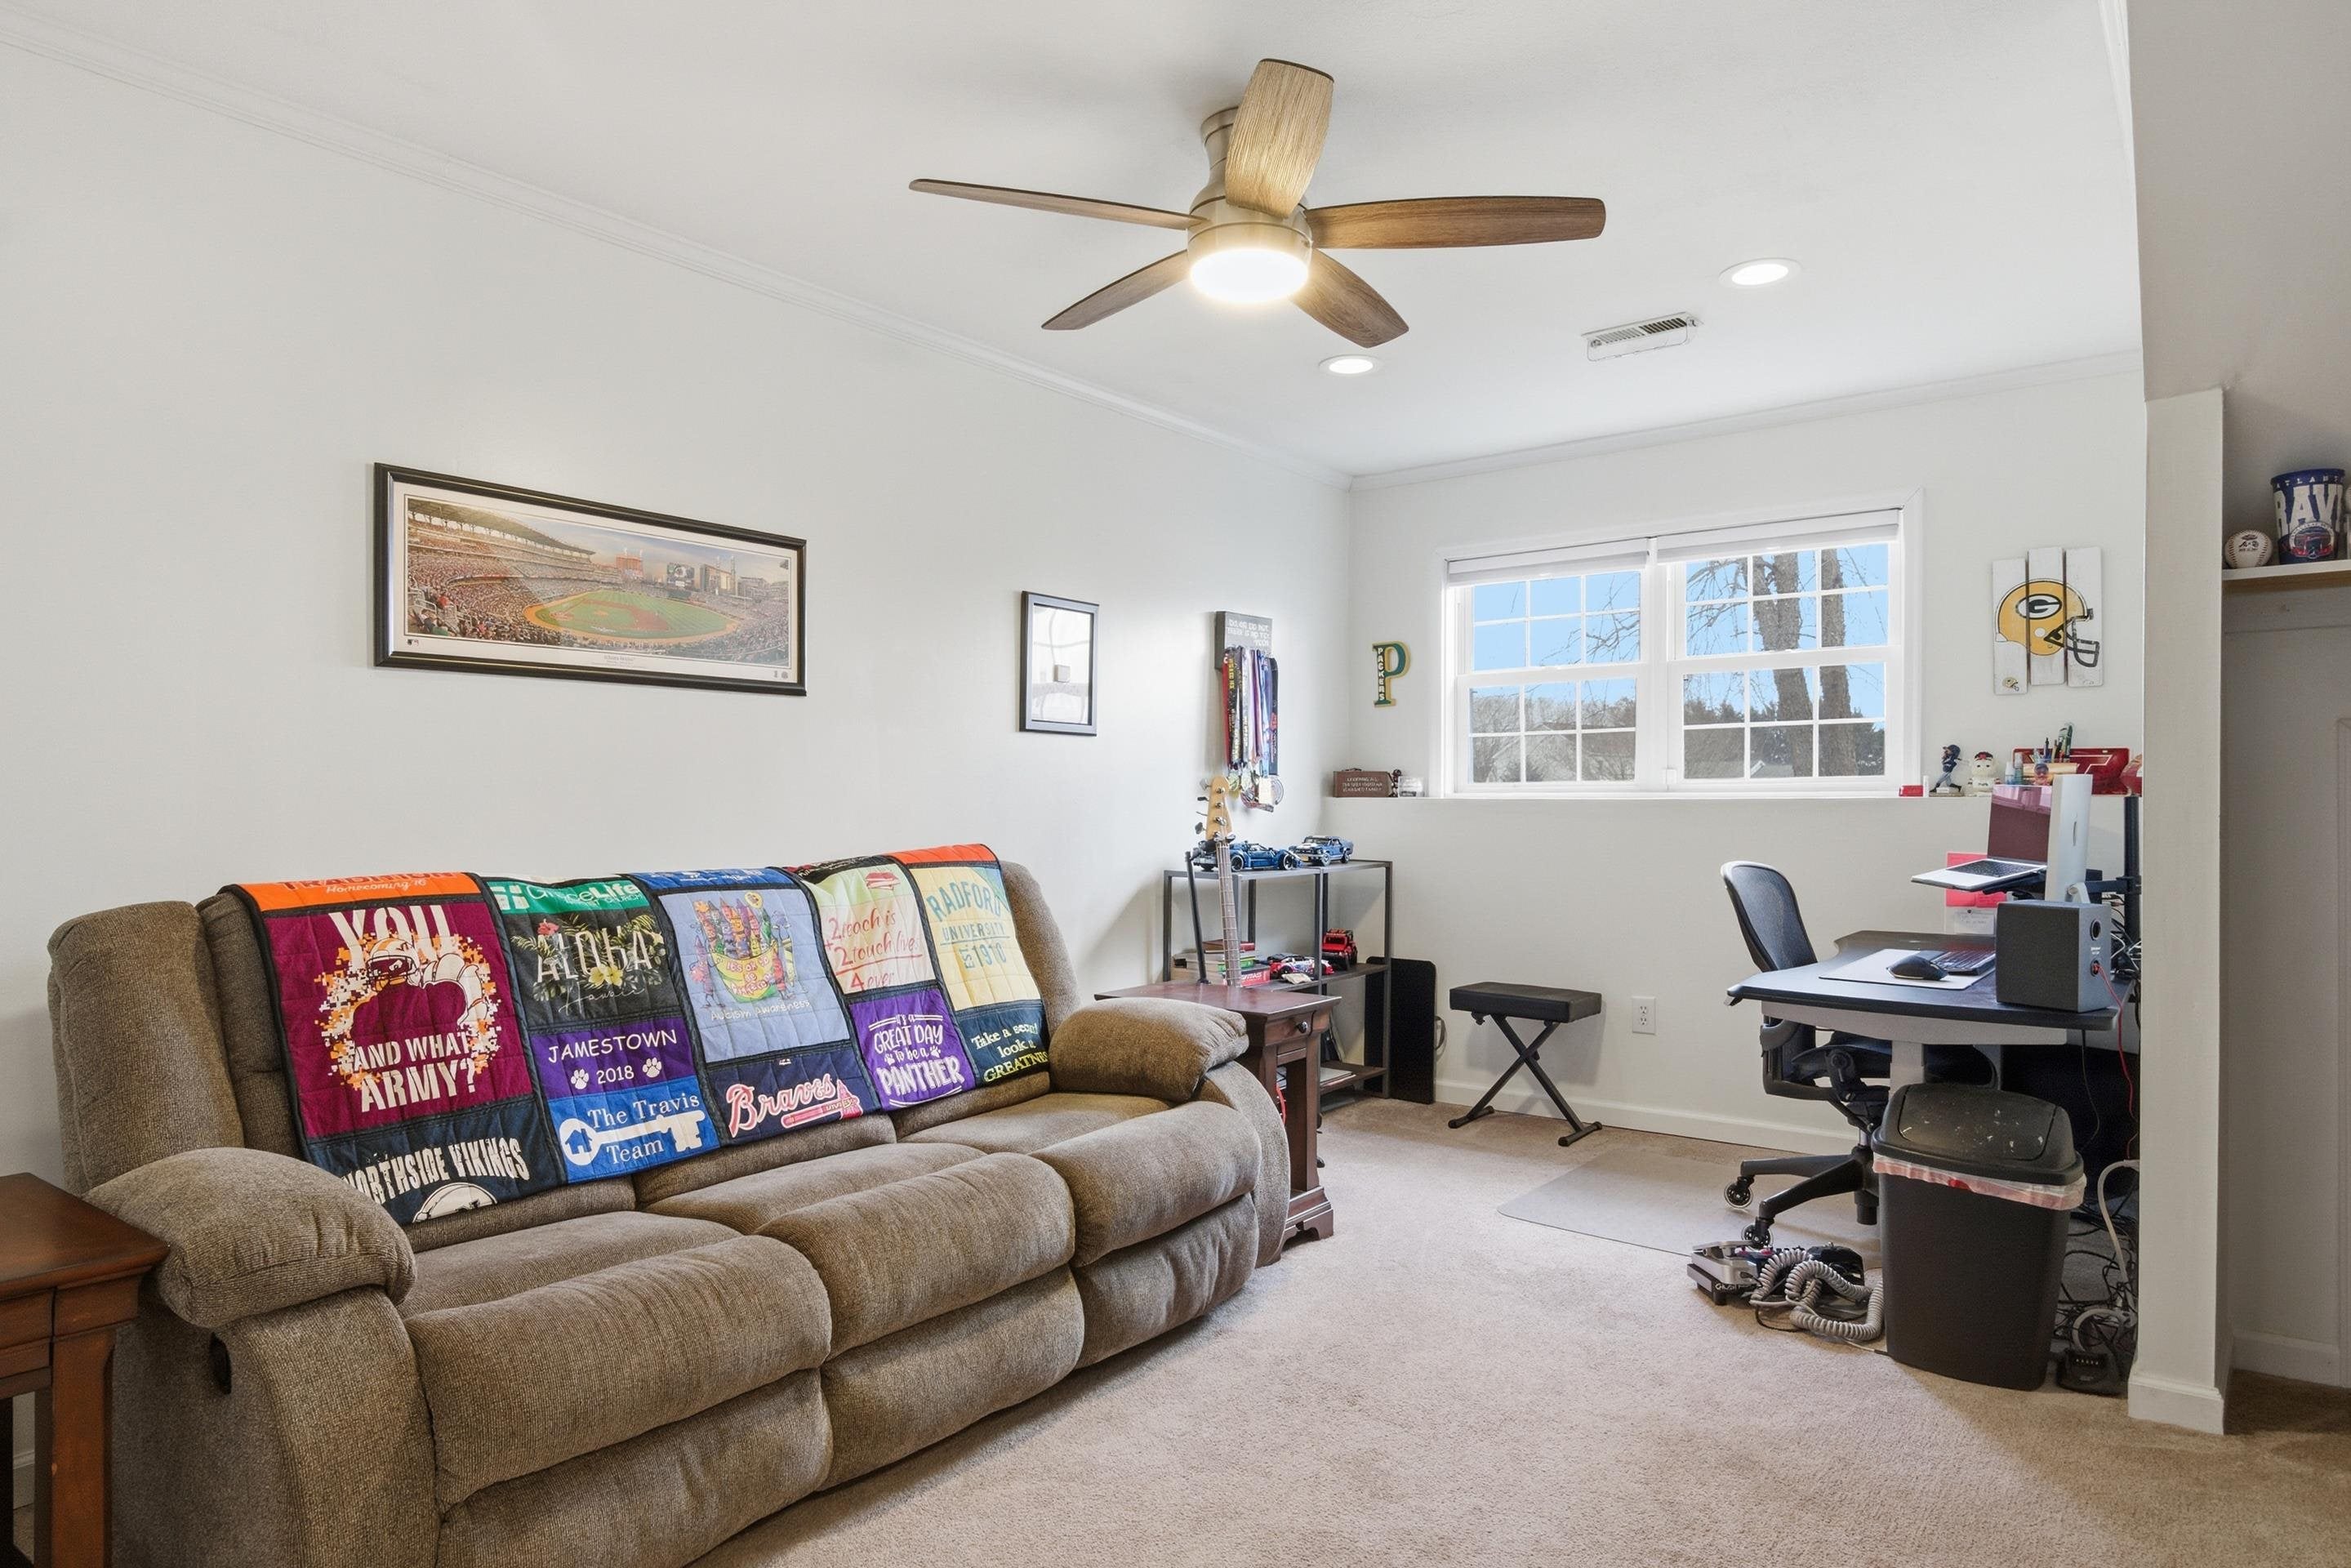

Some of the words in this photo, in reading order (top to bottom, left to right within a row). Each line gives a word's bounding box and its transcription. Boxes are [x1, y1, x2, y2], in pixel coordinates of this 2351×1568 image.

[326, 880, 408, 894] Homecoming
[926, 881, 1002, 922] RADFORD
[885, 910, 897, 926] is
[942, 922, 1006, 940] UNIVERSITY
[328, 904, 453, 972] YOU
[972, 942, 1007, 968] 1910
[754, 999, 810, 1015] Awareness
[354, 1040, 402, 1071] AND
[405, 1031, 471, 1062] WHAT
[548, 1029, 677, 1063] JAMESTOWN
[874, 1025, 912, 1054] GREAT
[914, 1024, 943, 1045] DAY
[971, 1032, 1001, 1050] Take
[1002, 1028, 1013, 1038] a
[997, 1039, 1029, 1058] look
[905, 1047, 920, 1060] be
[919, 1047, 929, 1058] a
[361, 1057, 476, 1112] ARMY?
[596, 1065, 635, 1085] 2018
[875, 1054, 965, 1097] PANTHER
[587, 1107, 628, 1129] The
[632, 1093, 701, 1121] Travis
[726, 1072, 836, 1138] Braves
[447, 1137, 530, 1181] VIKINGS
[606, 1139, 665, 1165] Team
